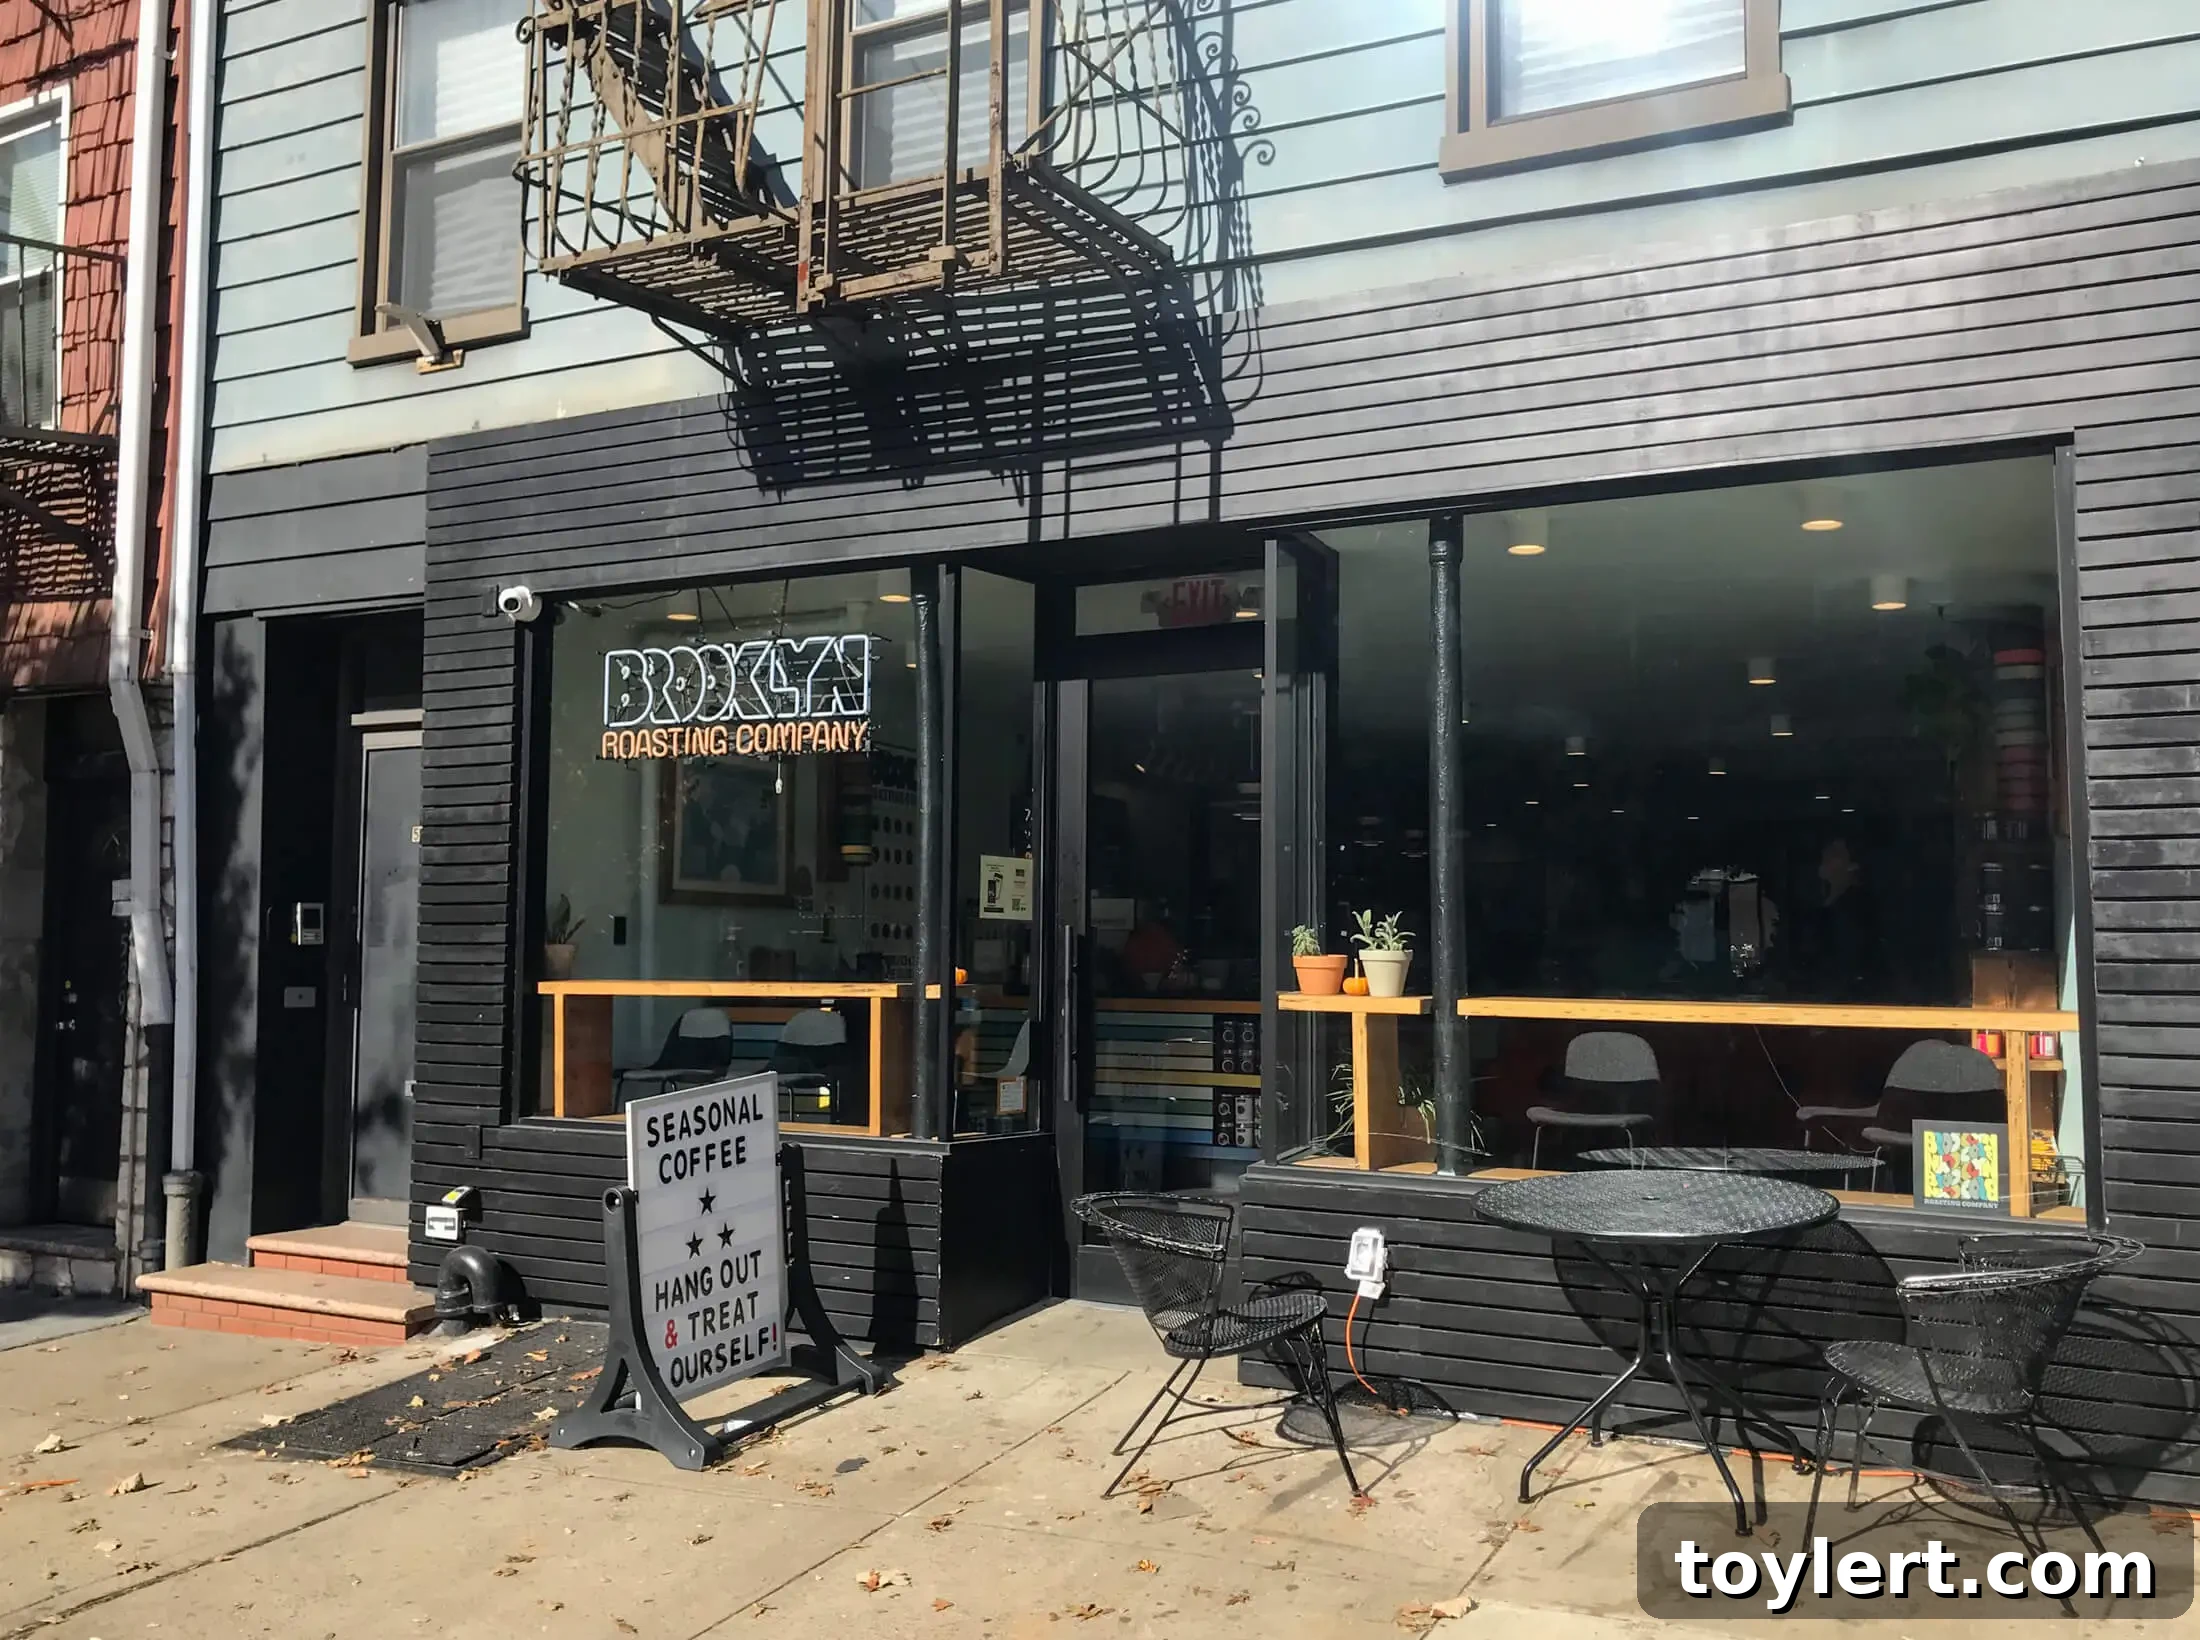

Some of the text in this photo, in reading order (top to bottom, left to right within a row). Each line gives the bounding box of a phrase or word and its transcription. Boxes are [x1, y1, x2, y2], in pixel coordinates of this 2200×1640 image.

[1172, 579, 1225, 624] EXIT
[603, 634, 870, 727] BROOKLYN
[601, 720, 869, 760] ROASTING COMPANY
[646, 1093, 763, 1148] SEASONAL
[658, 1135, 747, 1184] COFFEE
[655, 1249, 762, 1313] HANG OUT
[664, 1290, 759, 1349] & TREAT
[658, 1322, 777, 1387] OURSELF!
